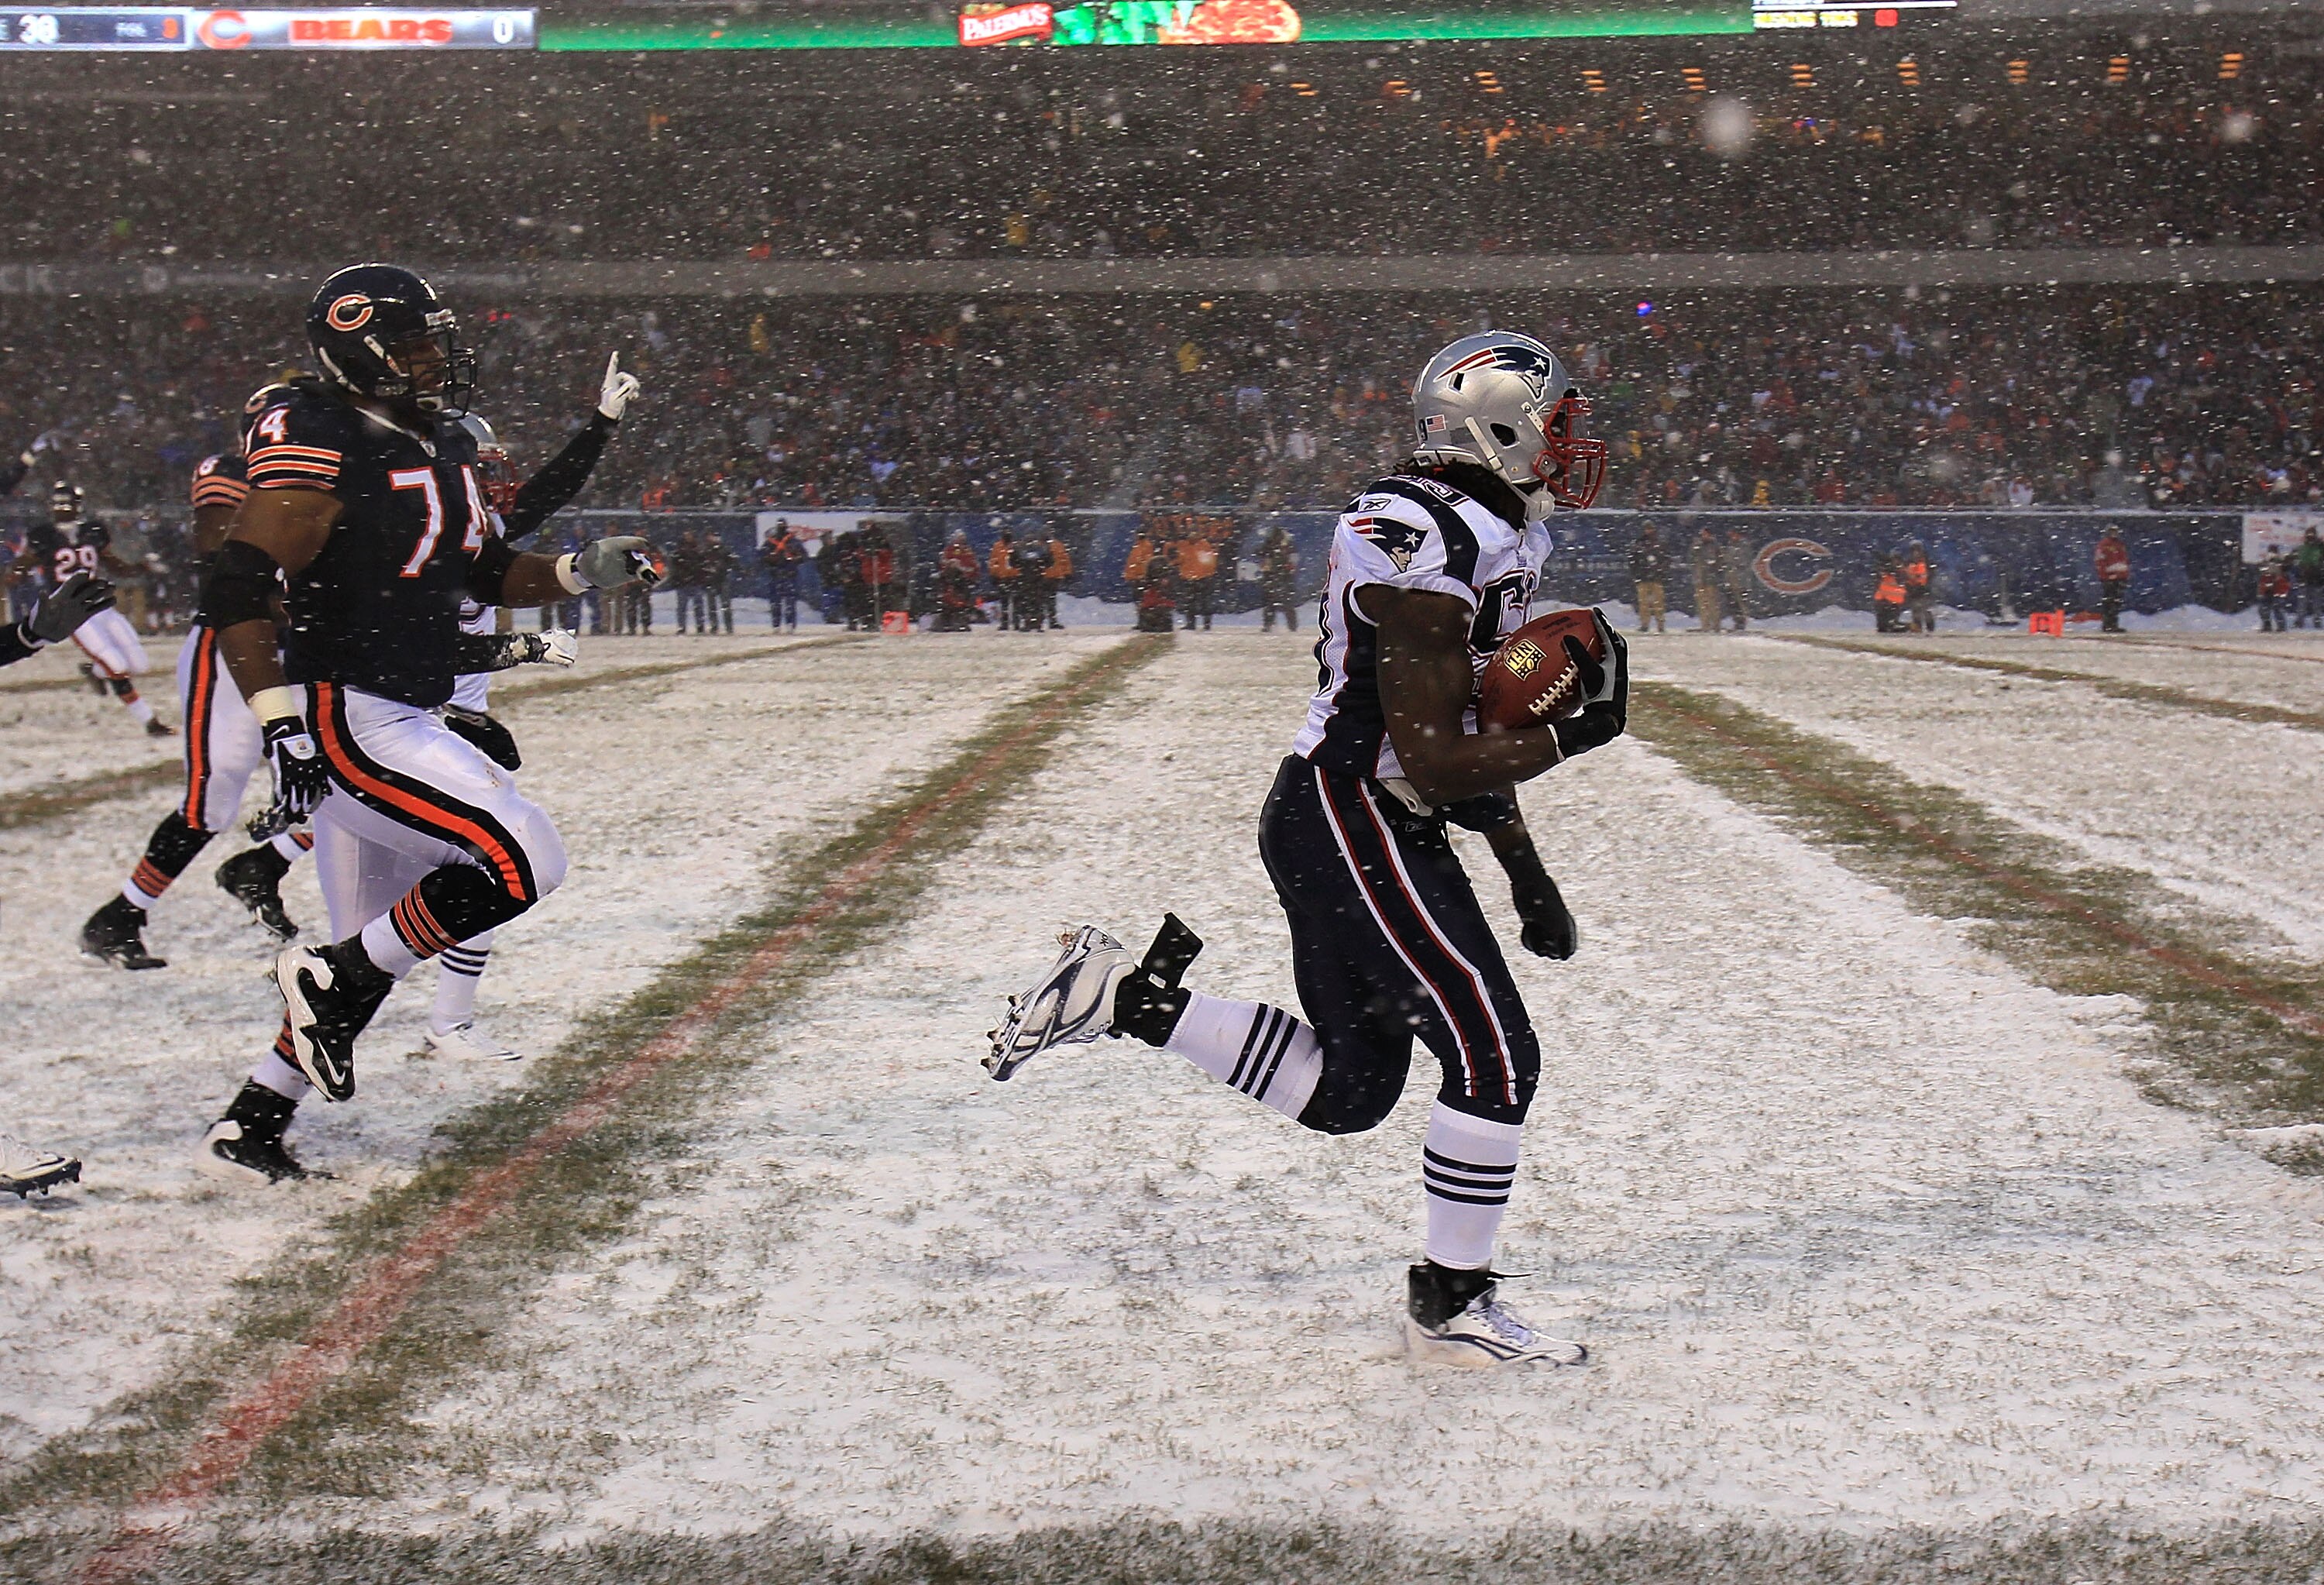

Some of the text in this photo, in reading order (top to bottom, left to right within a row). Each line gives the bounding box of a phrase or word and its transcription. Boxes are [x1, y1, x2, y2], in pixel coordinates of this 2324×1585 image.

[290, 19, 453, 43] BEARS
[493, 15, 514, 44] 0
[55, 545, 98, 582] 29
[1509, 641, 1534, 668] NFL
